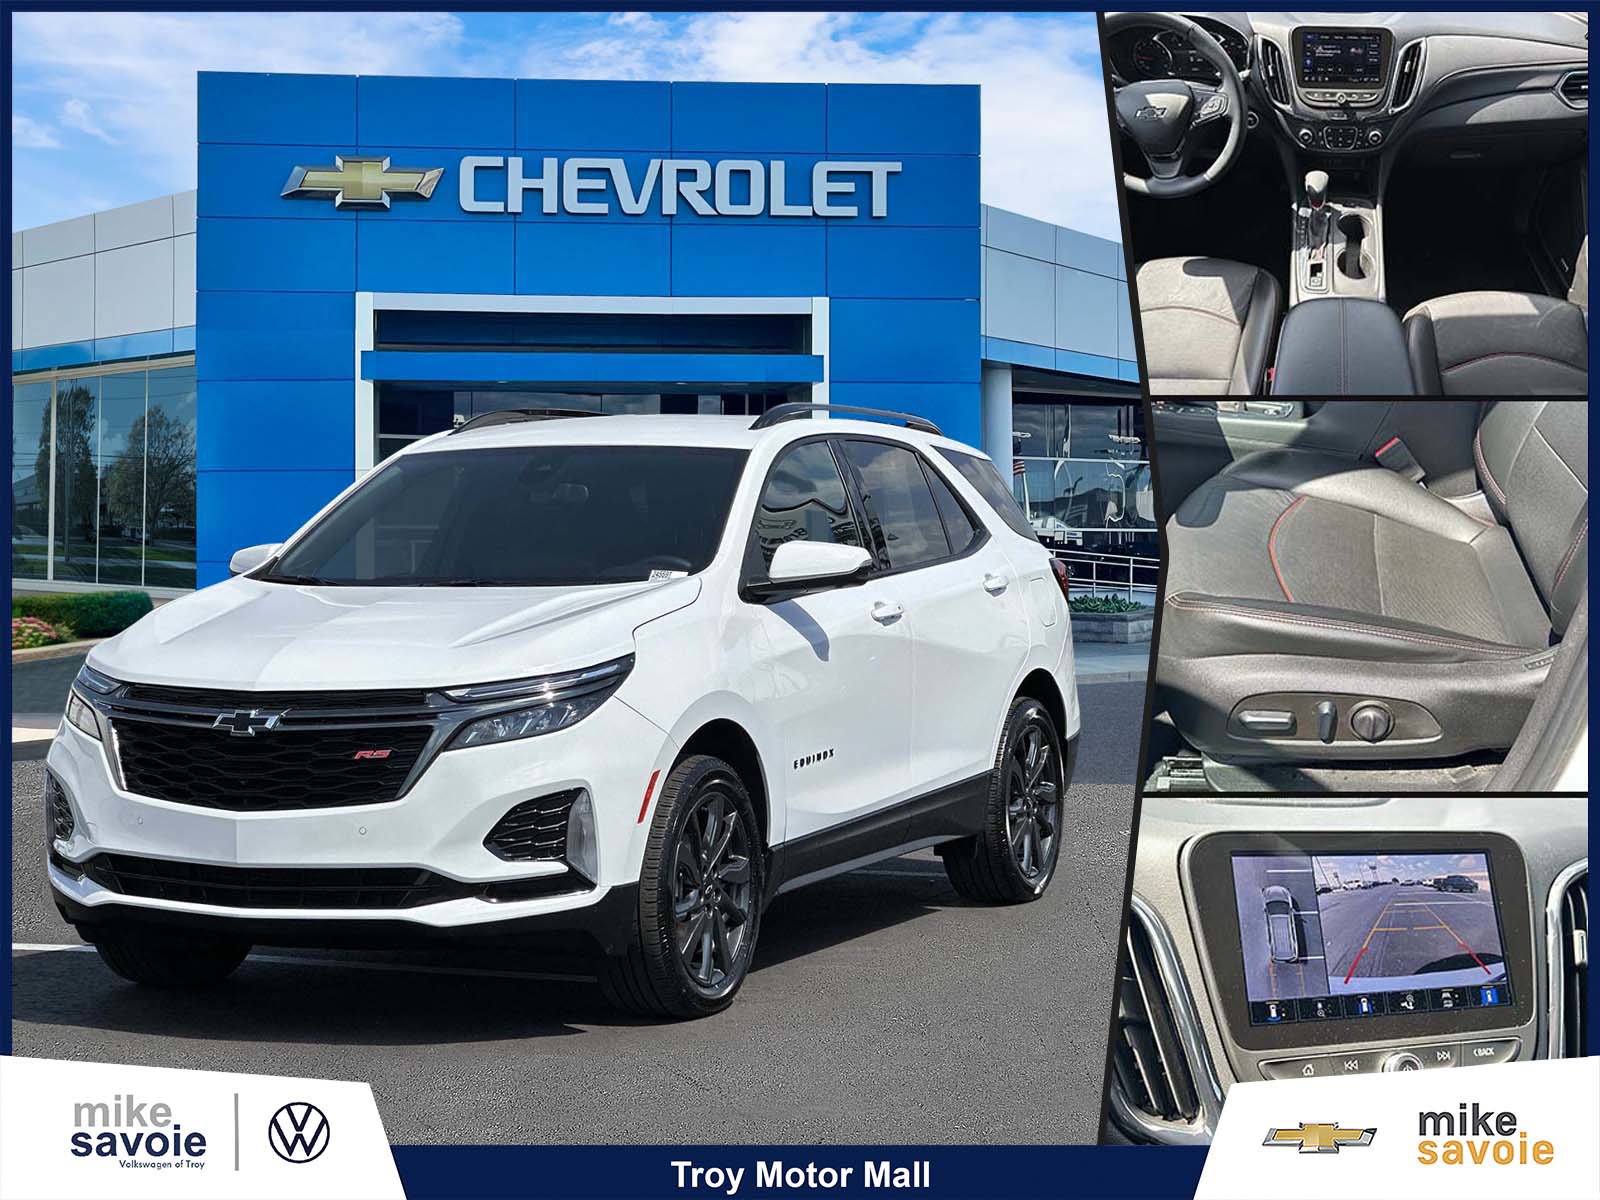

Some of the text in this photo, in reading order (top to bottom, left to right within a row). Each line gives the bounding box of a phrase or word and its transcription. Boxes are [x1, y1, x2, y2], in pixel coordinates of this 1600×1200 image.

[459, 156, 903, 218] CHEVROLET
[354, 749, 391, 760] RS
[793, 748, 834, 770] EQUINOX
